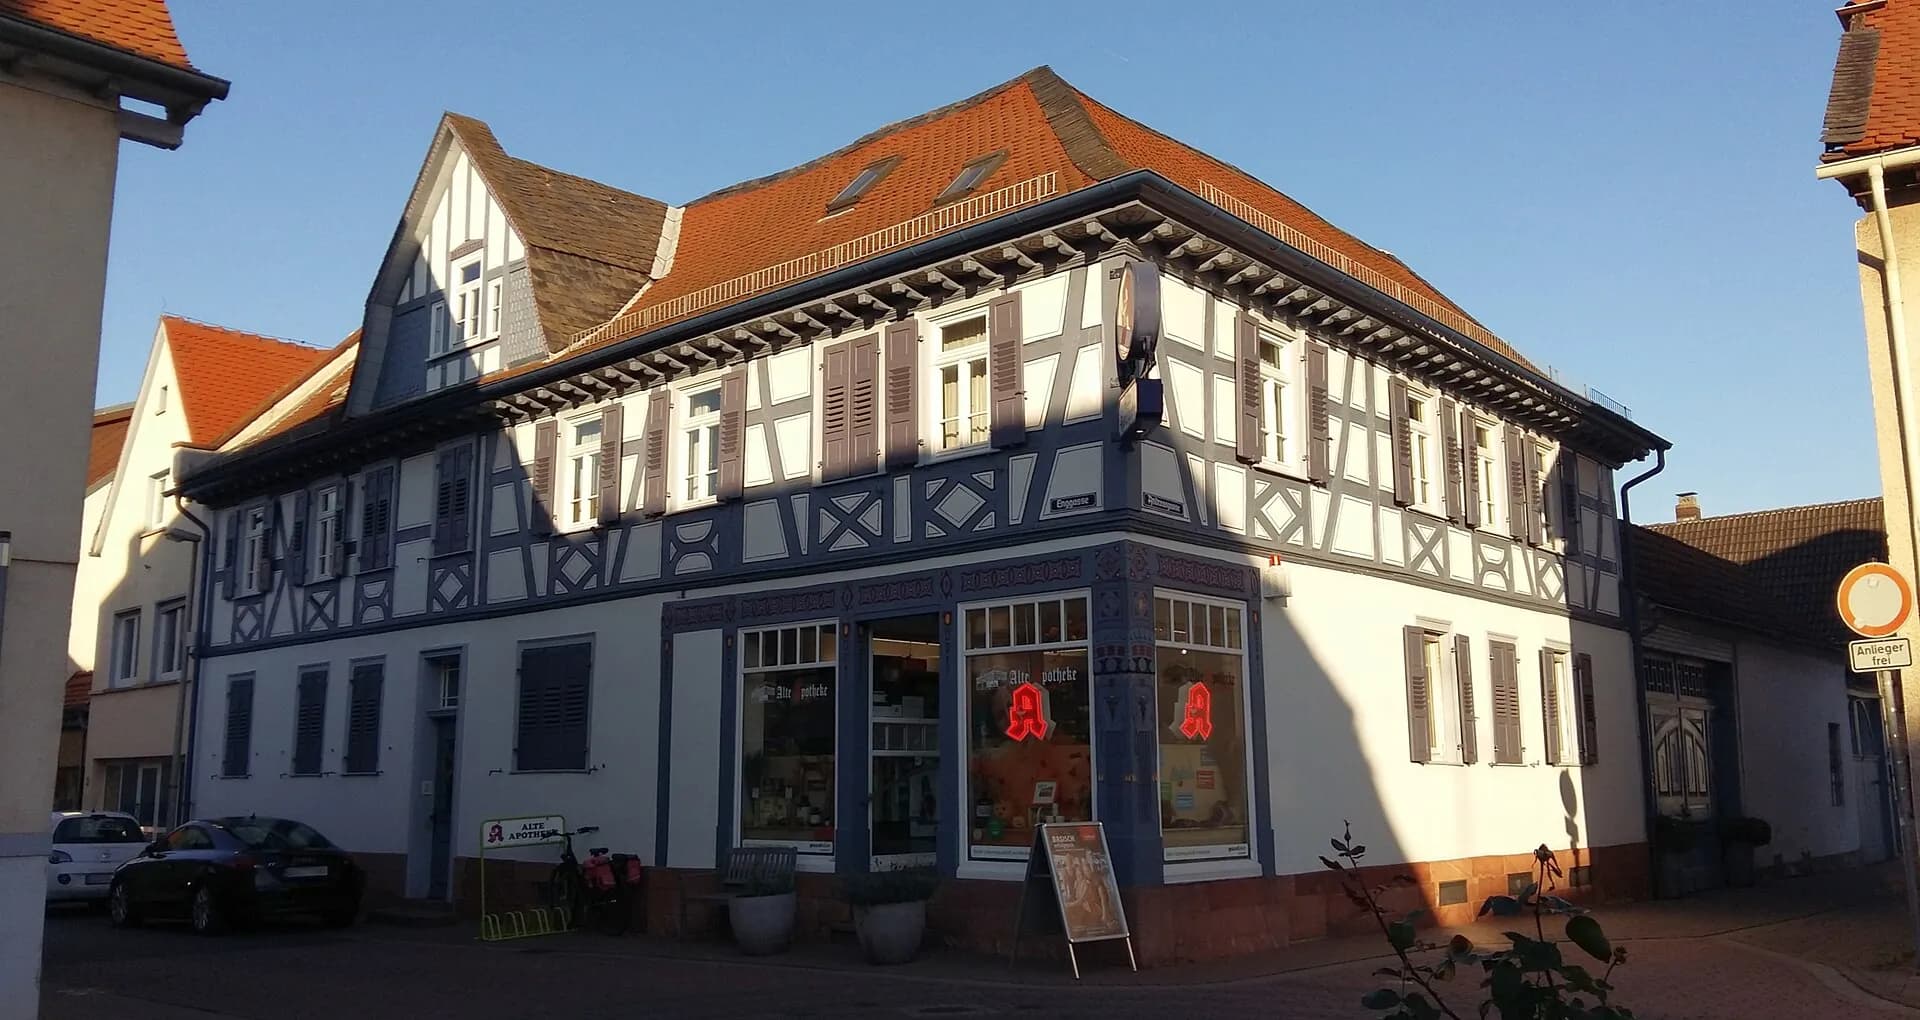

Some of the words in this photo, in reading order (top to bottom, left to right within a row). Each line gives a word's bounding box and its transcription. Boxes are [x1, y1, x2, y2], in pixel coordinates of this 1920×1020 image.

[1056, 496, 1090, 509] Enggasse
[1857, 643, 1905, 656] Anlieger
[1872, 654, 1892, 666] frei
[1008, 669, 1031, 685] Alte
[521, 822, 545, 831] ALTE
[508, 828, 559, 840] APOTHE
